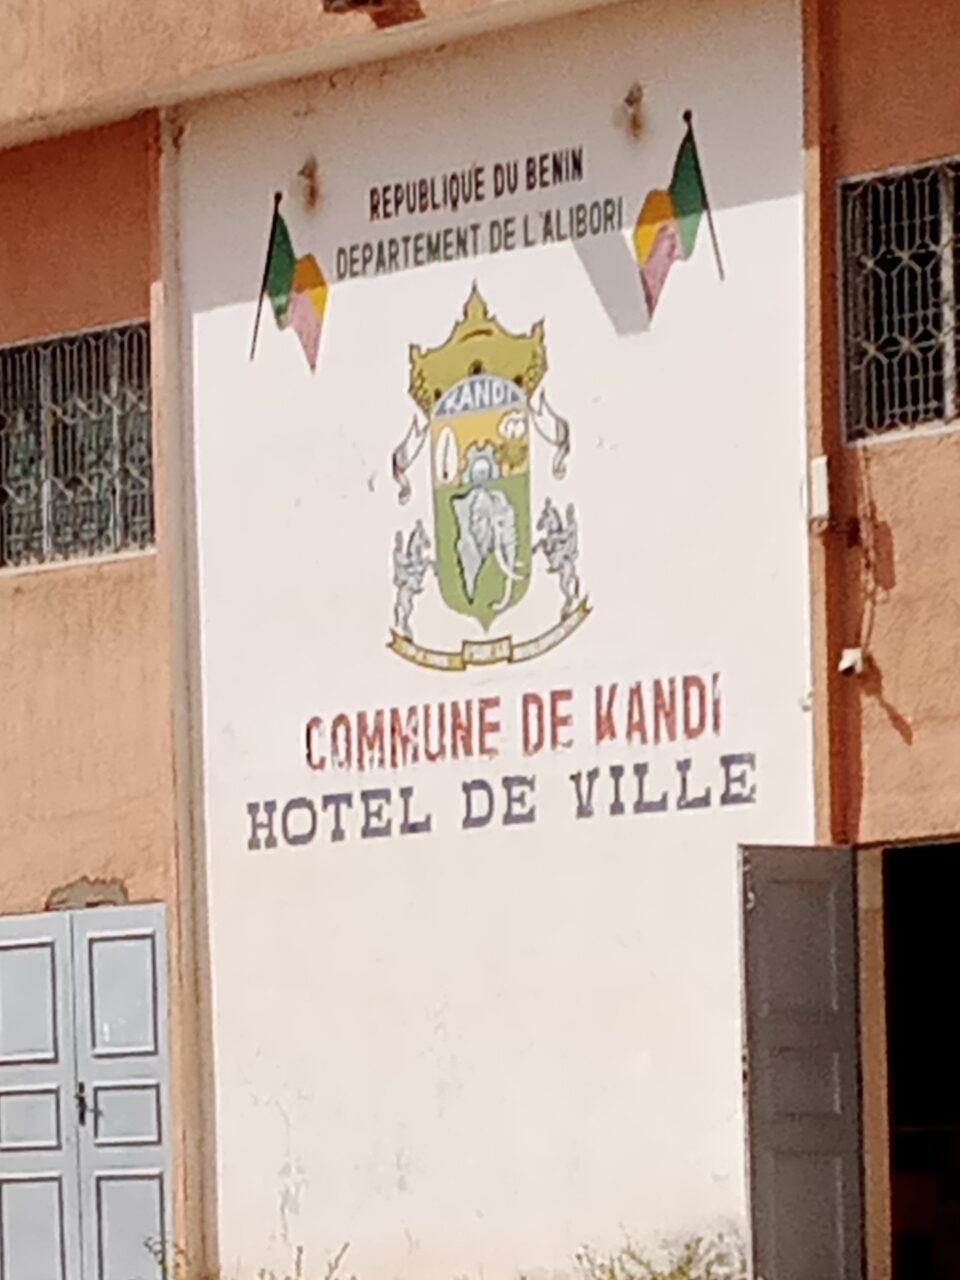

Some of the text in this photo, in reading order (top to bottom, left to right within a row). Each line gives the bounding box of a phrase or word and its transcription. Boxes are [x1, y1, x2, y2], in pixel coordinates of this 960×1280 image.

[493, 160, 520, 199] DU
[525, 145, 584, 191] BENIN
[336, 222, 482, 279] DEPARTEMENT
[489, 216, 517, 254] DE
[305, 673, 722, 772] COMMUNE DE KANDI
[247, 752, 758, 850] HOTEL DE VILLE
